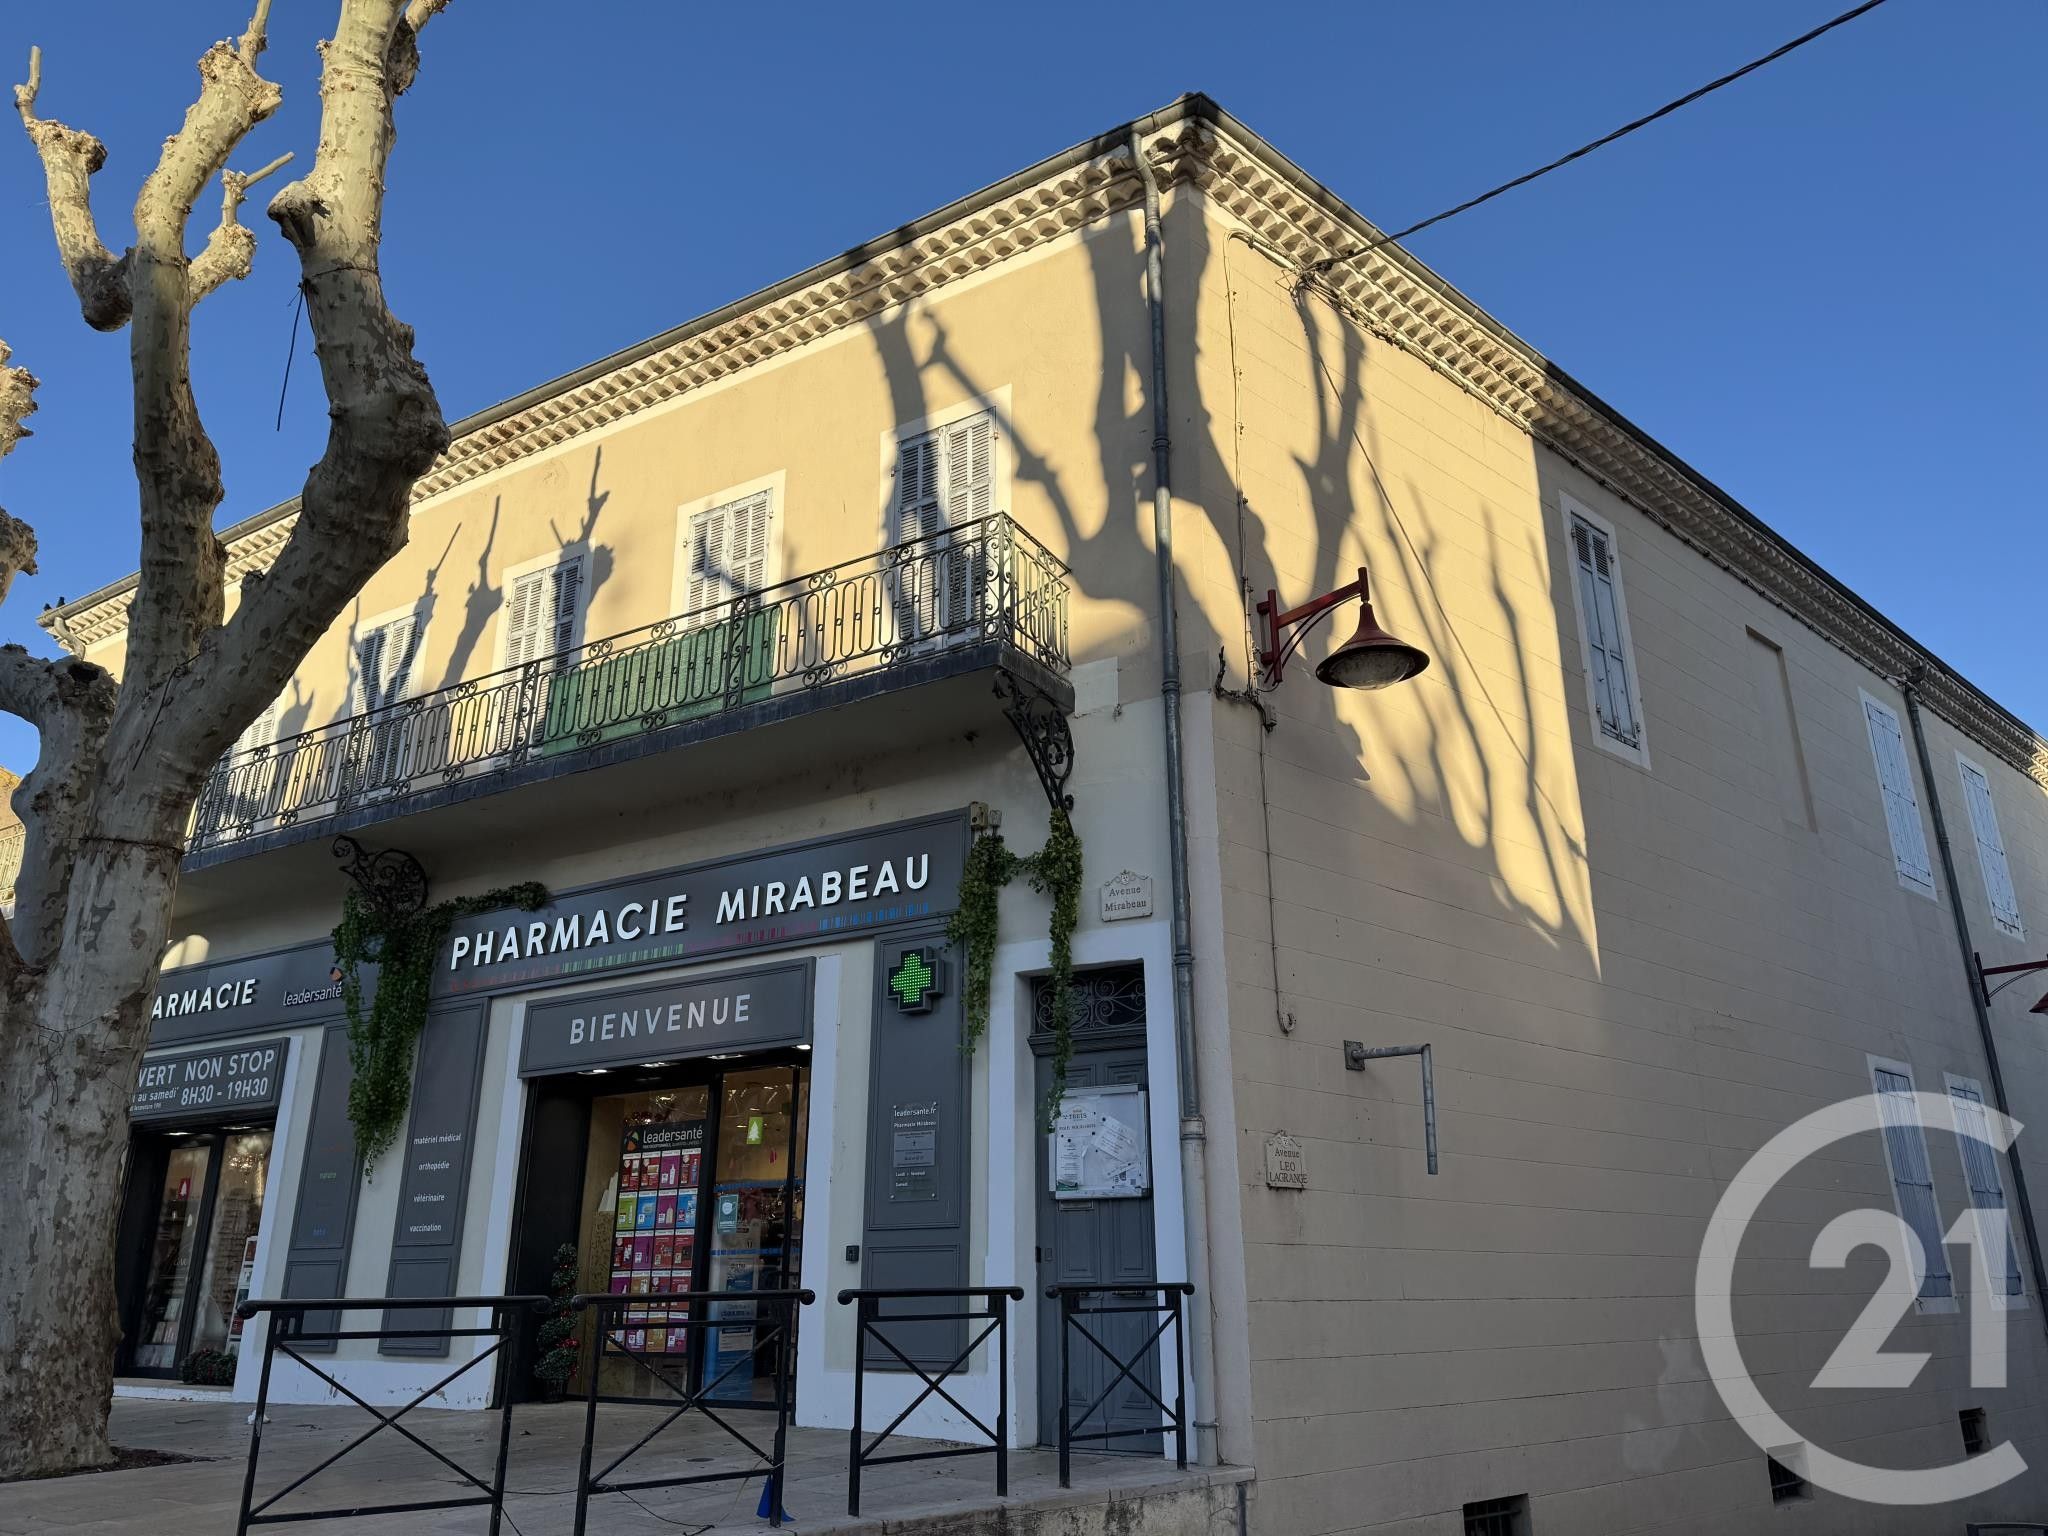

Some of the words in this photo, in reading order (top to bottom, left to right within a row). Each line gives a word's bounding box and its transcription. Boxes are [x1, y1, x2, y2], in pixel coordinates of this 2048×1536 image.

[1109, 887, 1141, 897] Avenue
[450, 893, 687, 970] PHARMACIE
[715, 853, 930, 925] MIRABEAU
[1104, 900, 1147, 912] Mirabeau
[151, 978, 256, 1019] ARMACIE
[282, 982, 343, 1006] leadersanté
[569, 993, 751, 1045] BIENVENUE
[138, 1063, 177, 1088] VERT
[184, 1056, 223, 1082] NON
[227, 1049, 275, 1076] STOP
[137, 1093, 147, 1102] au
[181, 1085, 214, 1106] 8H30
[227, 1077, 268, 1100] 19H30
[413, 1134, 438, 1145] matériel
[438, 1132, 462, 1143] médical
[642, 1125, 703, 1144] leadersanté
[1275, 1148, 1300, 1158] Avenue
[418, 1160, 450, 1171] orthopédie
[1279, 1160, 1296, 1172] LEO
[1269, 1171, 1308, 1184] LAGRANGE
[413, 1192, 446, 1203] vétérinaire
[409, 1223, 442, 1233] vaccination
